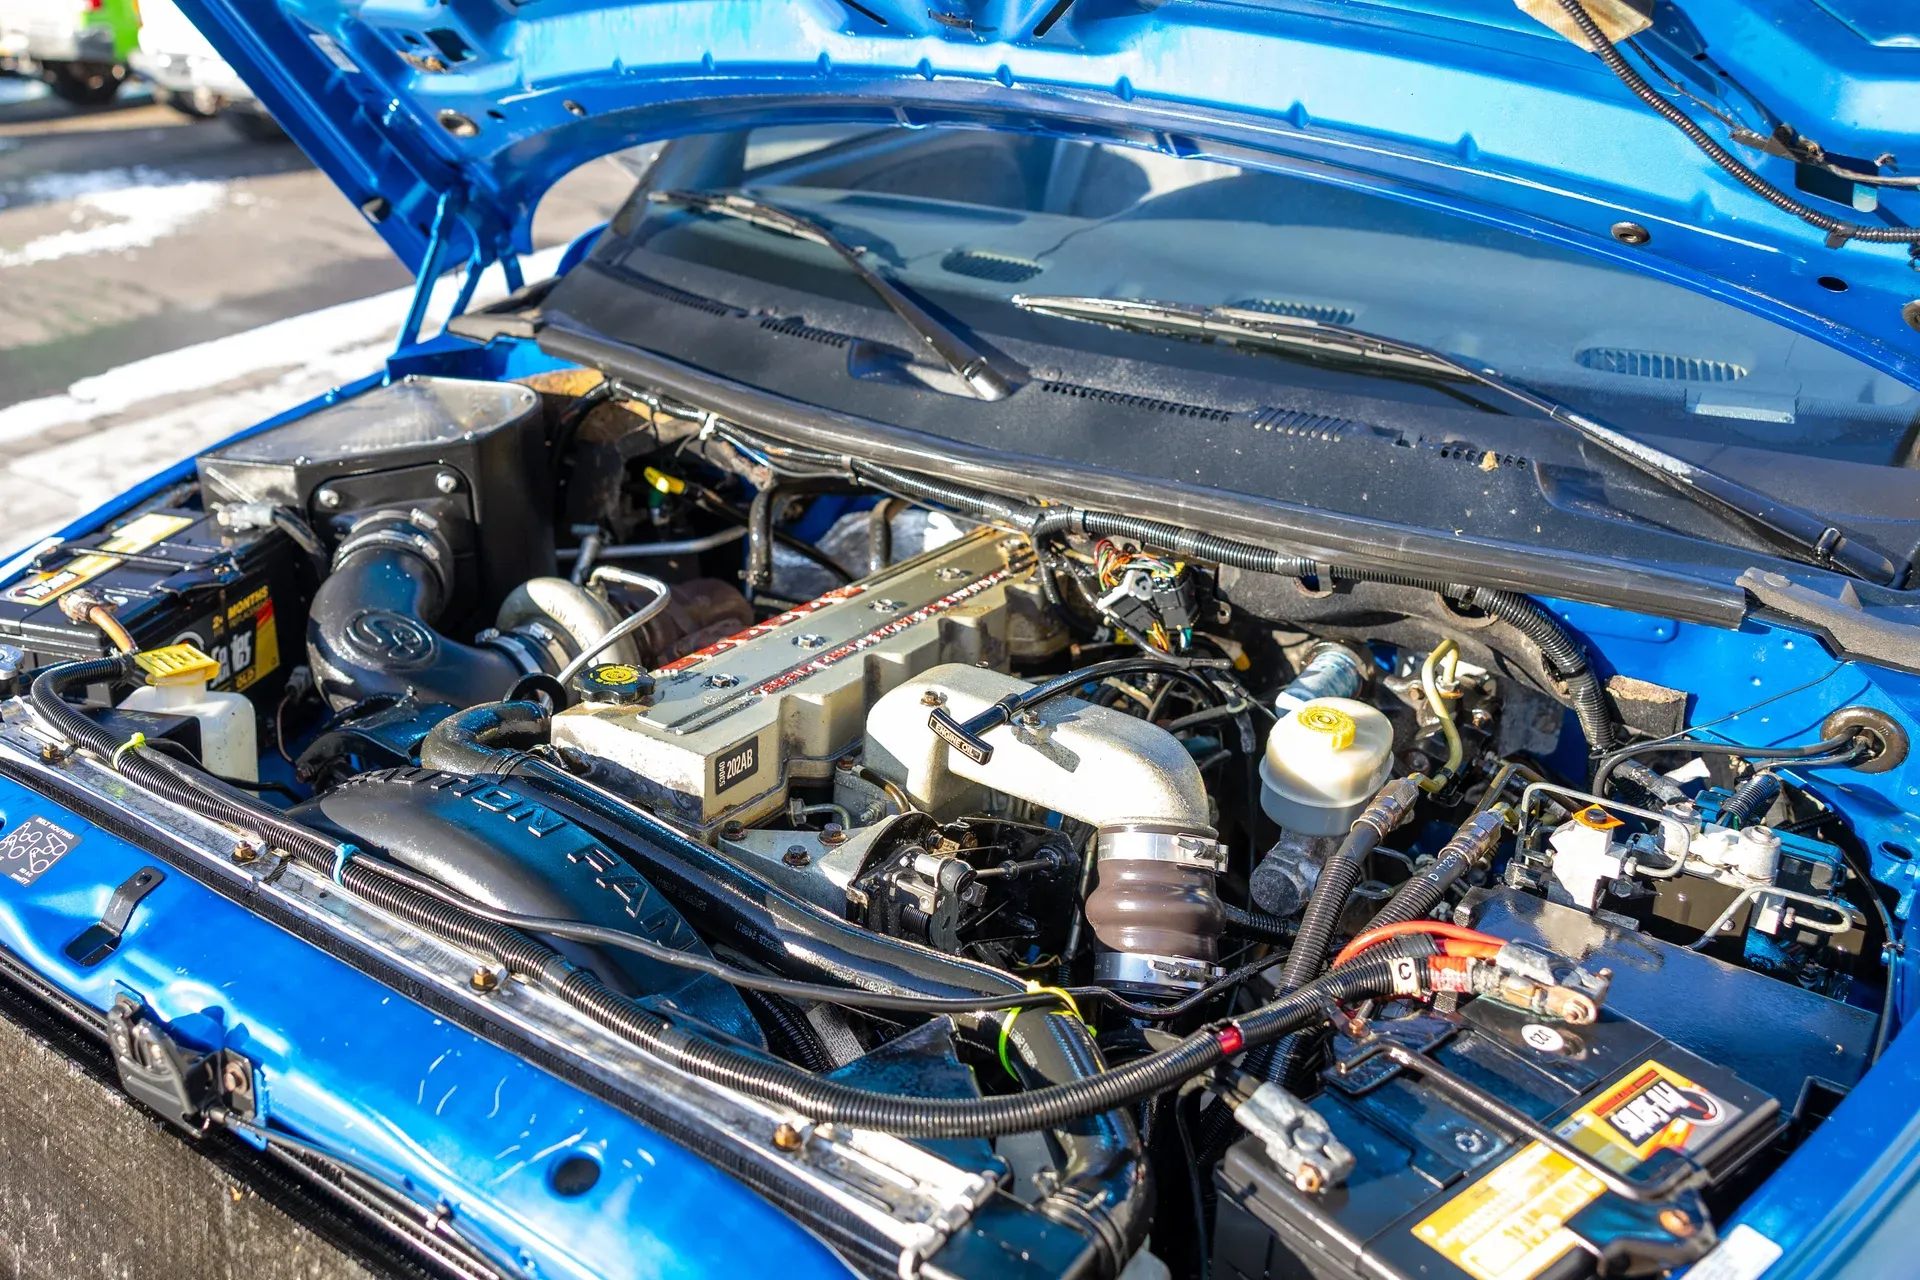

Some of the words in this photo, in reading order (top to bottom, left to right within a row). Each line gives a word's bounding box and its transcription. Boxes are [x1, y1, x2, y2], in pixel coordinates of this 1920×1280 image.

[228, 585, 268, 620] MONTHS
[936, 724, 962, 748] ENGINE
[961, 742, 974, 757] OIL
[718, 761, 726, 787] 53040
[727, 748, 753, 780] 202AB
[35, 816, 52, 827] BELT
[48, 822, 75, 840] ROUTING
[337, 766, 568, 838] AUTION
[567, 843, 698, 951] FAN
[1397, 961, 1413, 981] C
